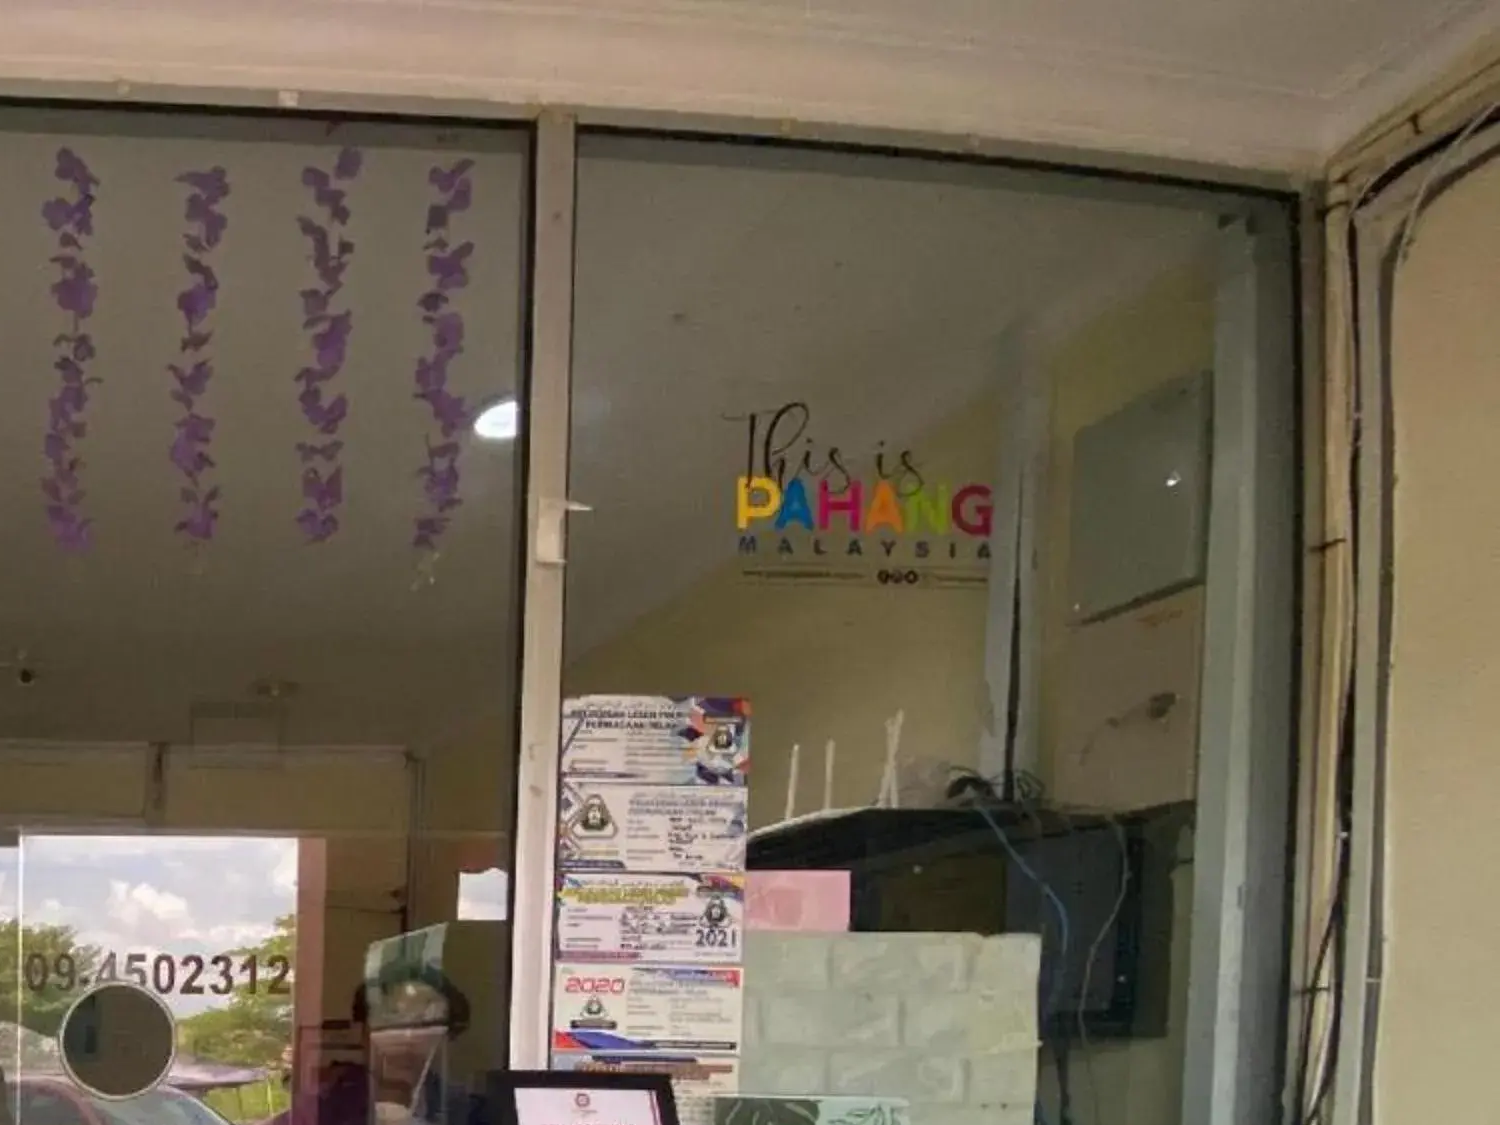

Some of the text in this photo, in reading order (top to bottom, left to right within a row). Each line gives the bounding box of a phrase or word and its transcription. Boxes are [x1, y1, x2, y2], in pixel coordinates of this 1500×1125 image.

[722, 402, 925, 497] This is
[737, 475, 994, 537] PAHANG
[738, 535, 992, 559] MALAYSIA
[696, 929, 738, 948] 2021
[564, 976, 626, 995] 2020
